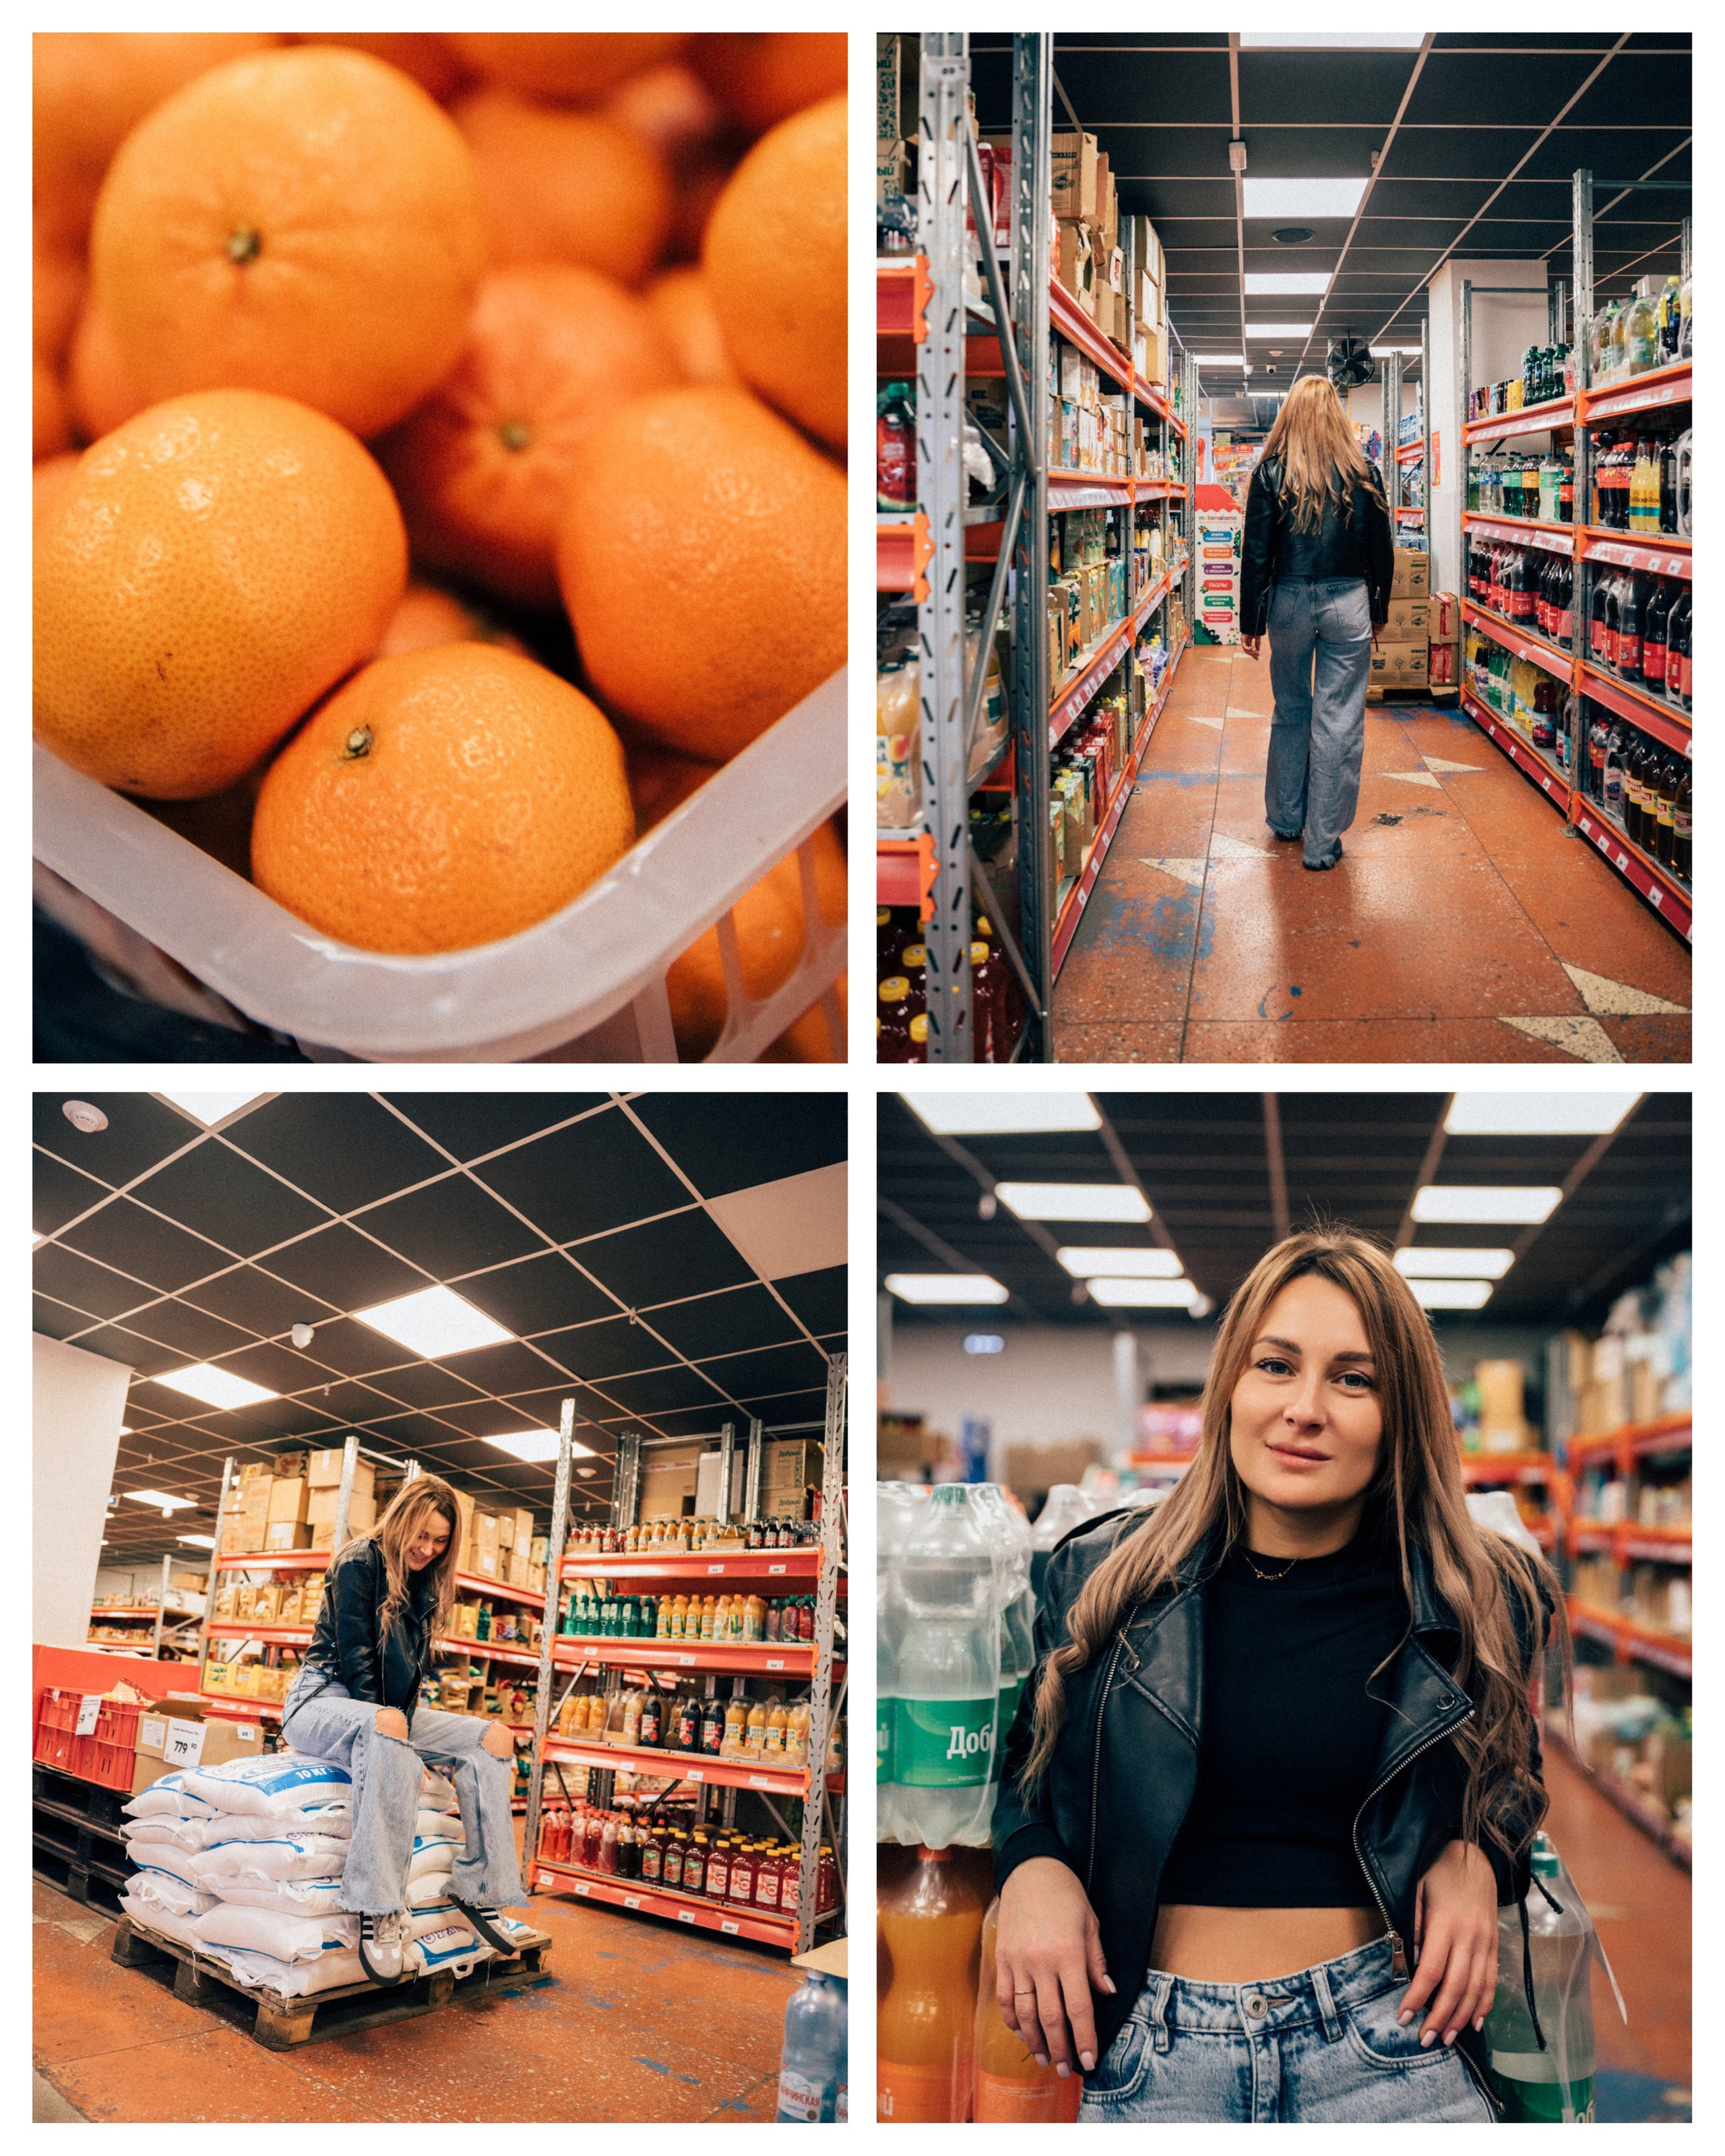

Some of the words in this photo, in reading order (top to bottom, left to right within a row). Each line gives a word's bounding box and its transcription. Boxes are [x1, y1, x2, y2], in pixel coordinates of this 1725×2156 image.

[174, 1740, 188, 1754] 779
[295, 1769, 311, 1780] 10
[312, 1767, 328, 1777] КГ
